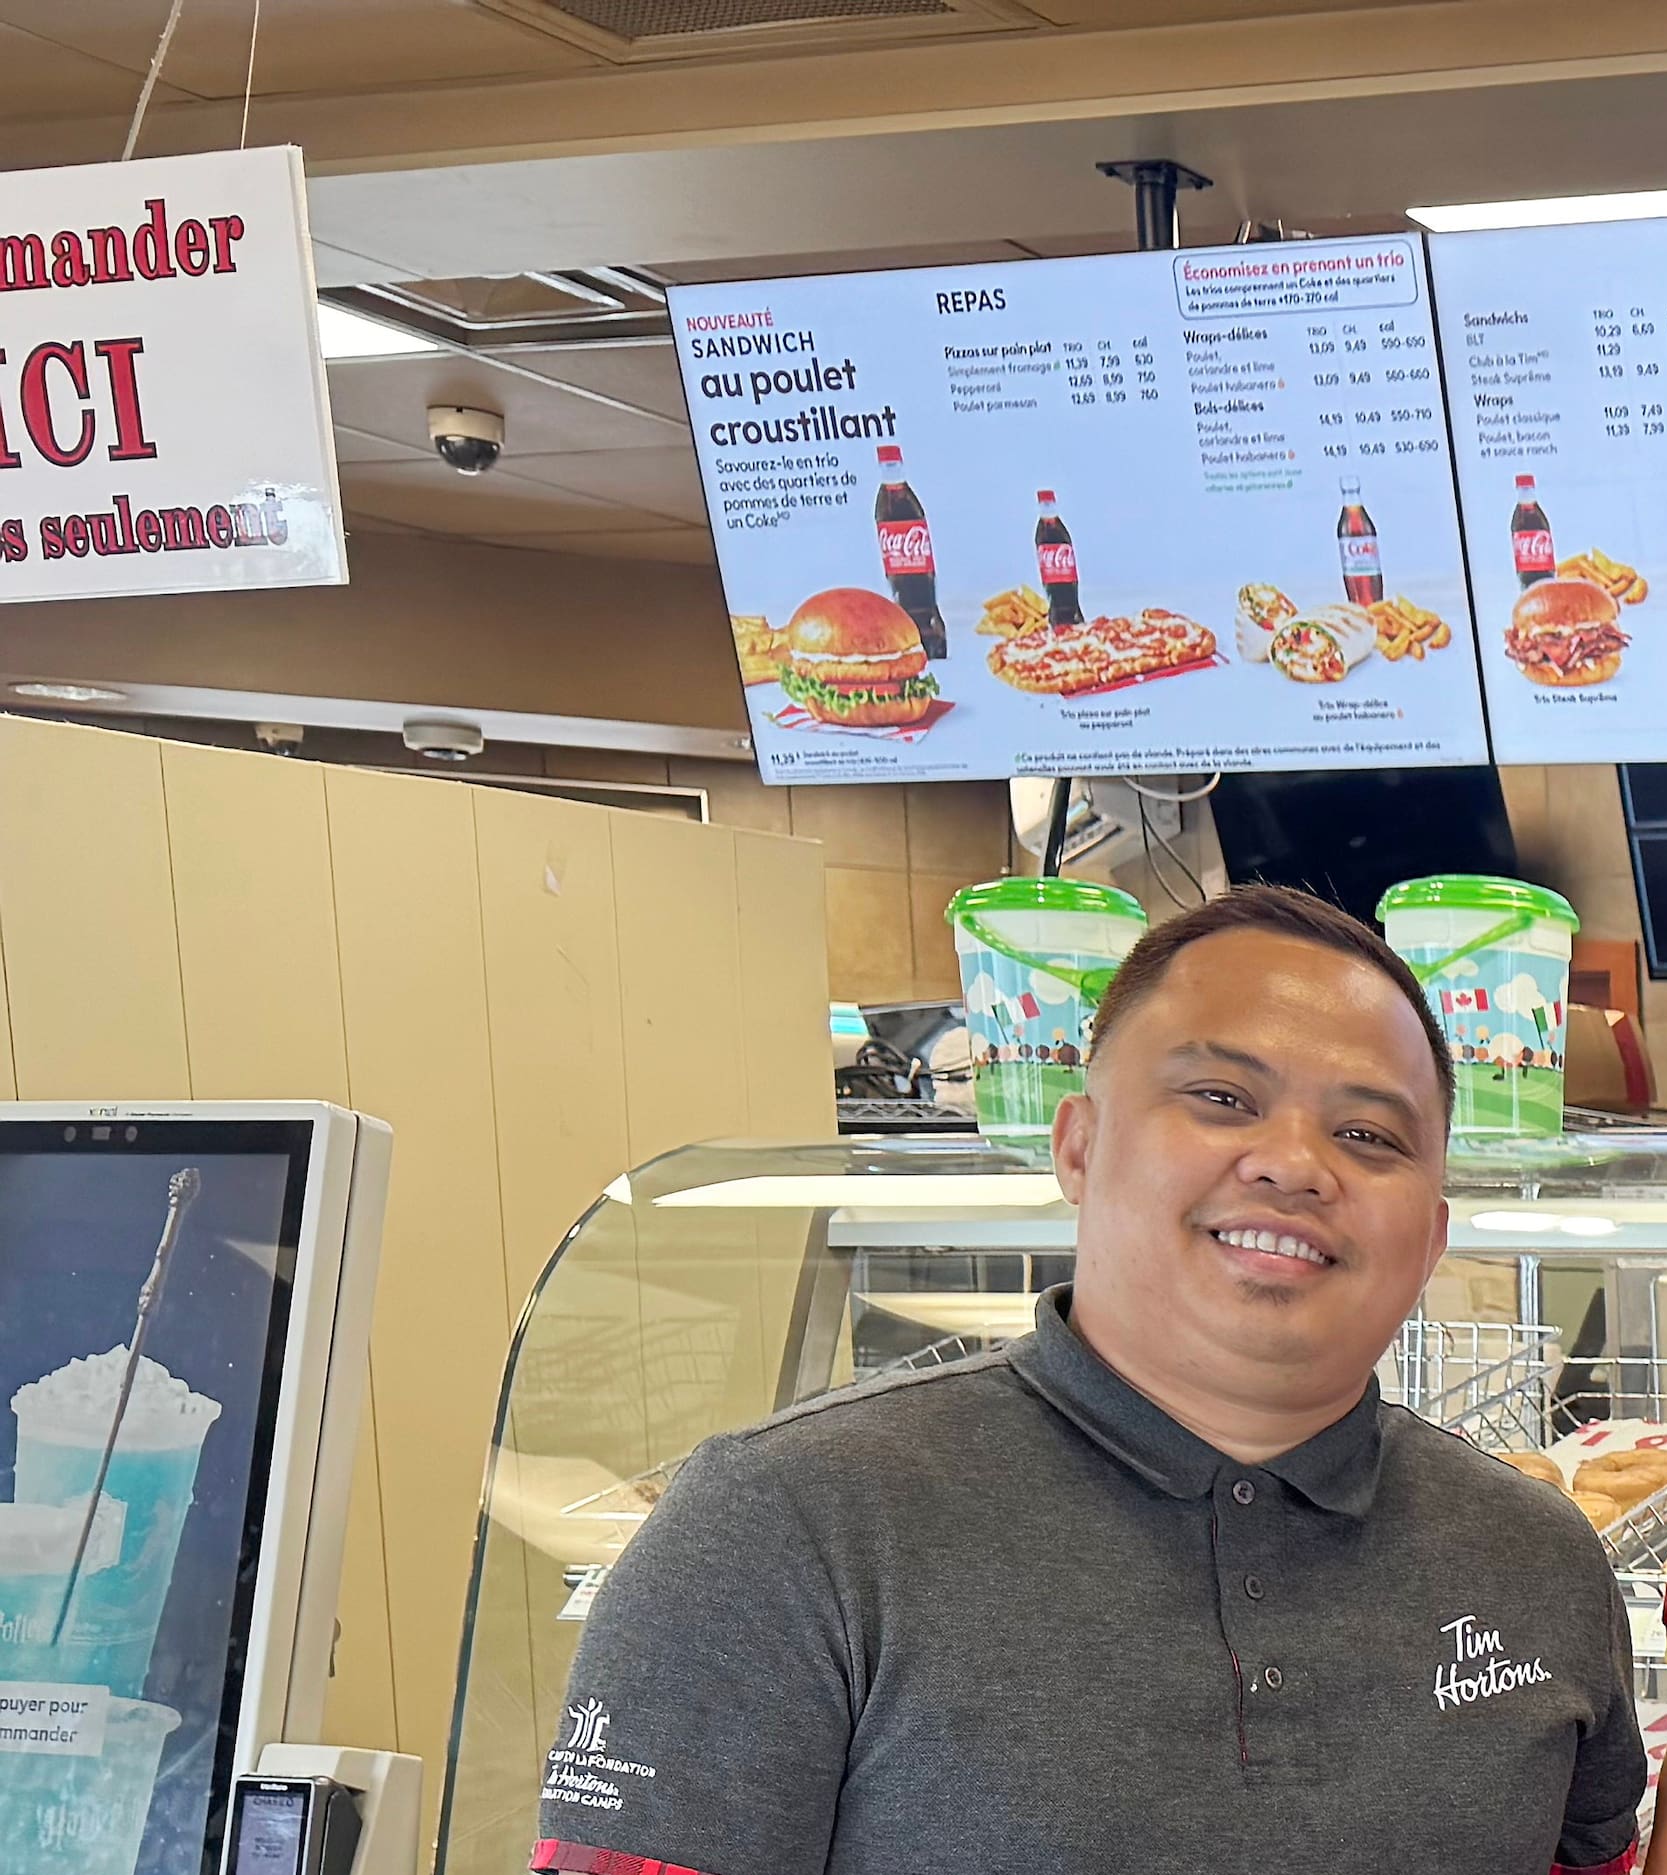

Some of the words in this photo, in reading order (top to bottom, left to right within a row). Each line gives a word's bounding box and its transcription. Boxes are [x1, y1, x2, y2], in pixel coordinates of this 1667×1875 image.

[1183, 259, 1268, 280] Économisez
[1272, 262, 1289, 273] en
[1293, 258, 1350, 277] prenant
[1356, 258, 1373, 269] un
[1377, 249, 1404, 268] trio
[937, 288, 1007, 316] REPAS
[686, 306, 773, 331] NOUVEAUTÉ
[692, 331, 815, 358] SANDWICH
[701, 374, 742, 399] au
[752, 358, 857, 404] poulet
[711, 406, 896, 446] croustillant
[716, 457, 794, 474] Savourez-le
[815, 453, 839, 468] trio
[720, 477, 750, 492] avec
[778, 473, 838, 491] quartiers
[841, 473, 857, 486] de
[724, 497, 778, 513] pommes
[782, 493, 798, 508] de
[800, 493, 832, 506] terre
[836, 492, 848, 504] et
[41, 488, 287, 559] seulement
[728, 518, 743, 529] un
[1440, 1614, 1504, 1662] Tim
